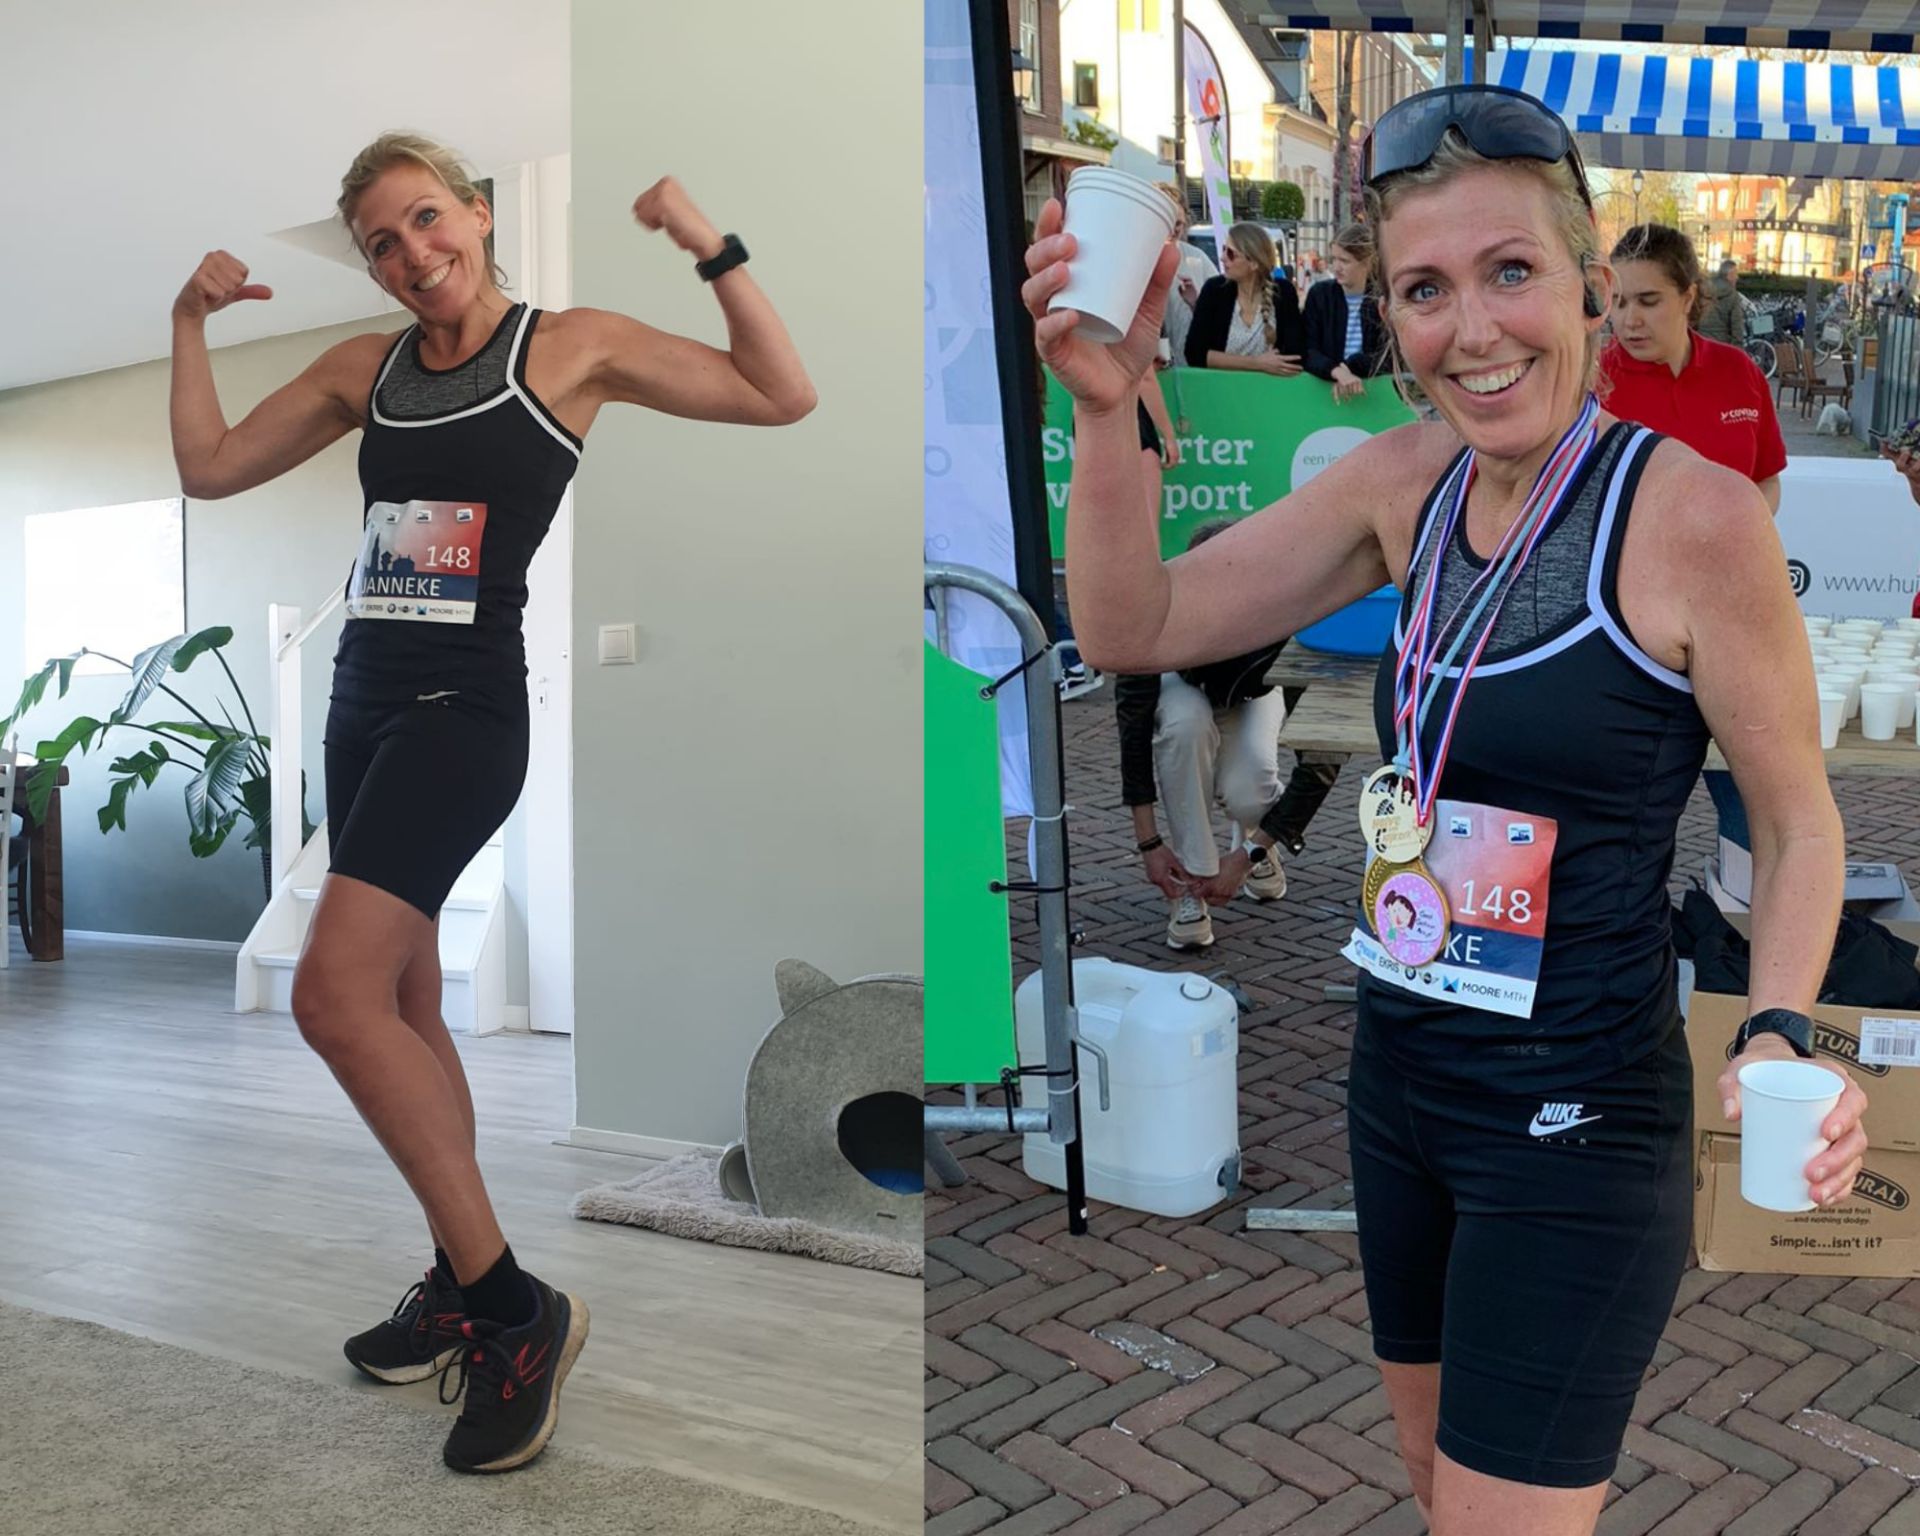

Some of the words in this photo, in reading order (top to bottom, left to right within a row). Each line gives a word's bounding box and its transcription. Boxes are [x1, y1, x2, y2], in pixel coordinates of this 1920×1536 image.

[1042, 427, 1254, 465] Srter
[1163, 481, 1254, 519] port
[425, 545, 471, 569] 148
[1459, 879, 1532, 924] 148
[1462, 982, 1501, 999] MOORE
[1503, 989, 1528, 1004] MTH
[1539, 1103, 1584, 1123] NIKE
[1865, 1236, 1883, 1248] it?
